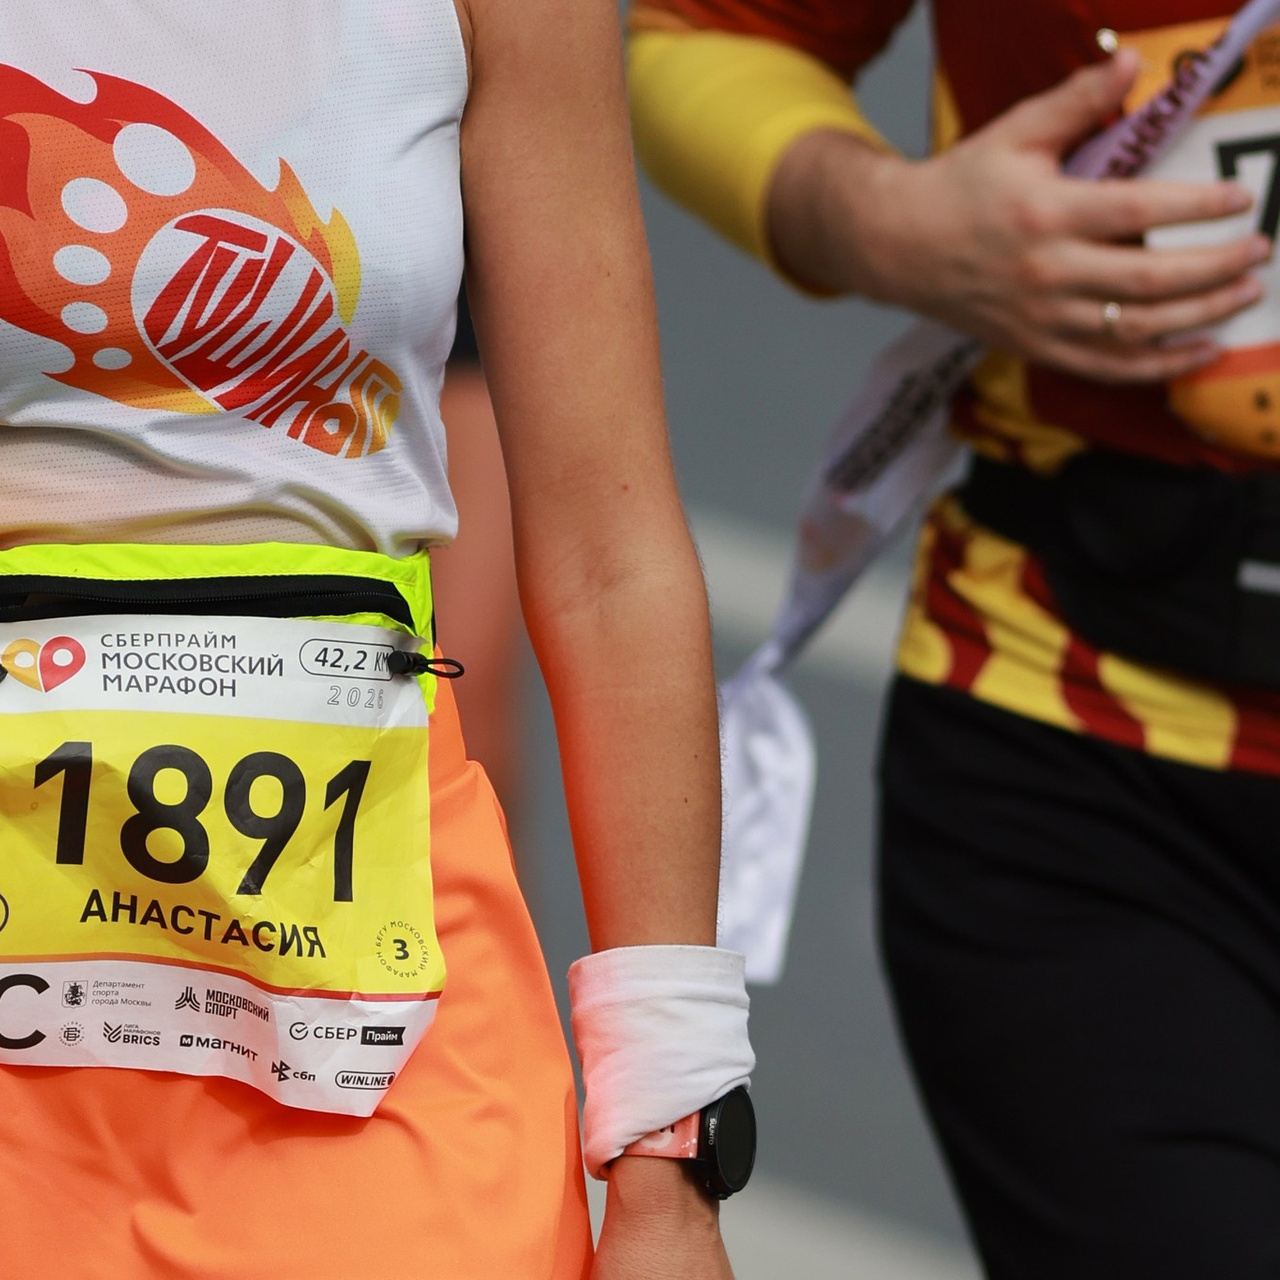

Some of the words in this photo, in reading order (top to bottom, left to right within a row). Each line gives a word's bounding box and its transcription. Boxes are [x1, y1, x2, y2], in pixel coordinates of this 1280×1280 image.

[100, 630, 237, 649] СБЕРПРАЙМ
[101, 652, 284, 676] МОСКОВСКИЙ
[314, 647, 368, 672] 42,2
[102, 675, 237, 697] МАРАФОН
[327, 685, 384, 710] 2026
[33, 740, 373, 903] 1891
[80, 888, 327, 959] АНАСТАСИЯ
[393, 938, 410, 960] 3
[92, 980, 145, 989] Департамент
[92, 989, 119, 997] спорта
[91, 998, 119, 1006] города
[121, 998, 152, 1007] Москвы
[205, 989, 270, 1022] МОСКОВСКИЙ
[205, 1002, 239, 1020] СПОРТ
[122, 1034, 161, 1047] BRICS
[313, 1026, 358, 1040] СБЕР
[366, 1031, 398, 1042] Прайм
[341, 1074, 387, 1086] WINLINE
